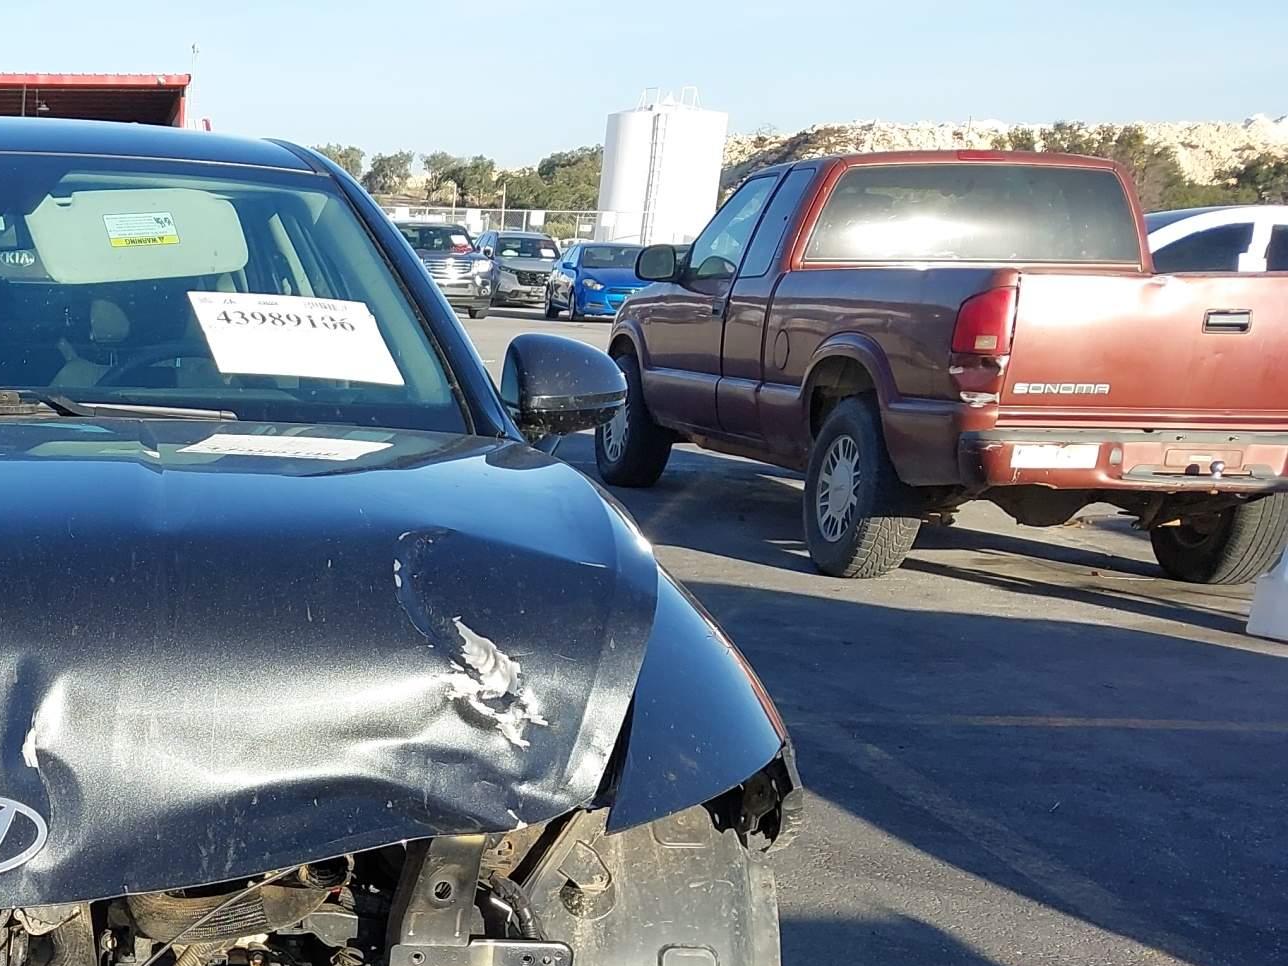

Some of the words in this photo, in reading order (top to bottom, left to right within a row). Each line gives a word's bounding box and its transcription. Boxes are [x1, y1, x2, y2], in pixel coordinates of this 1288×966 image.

[124, 237, 157, 245] WARNING
[5, 252, 30, 264] KIA
[1012, 382, 1111, 395] SONOMA
